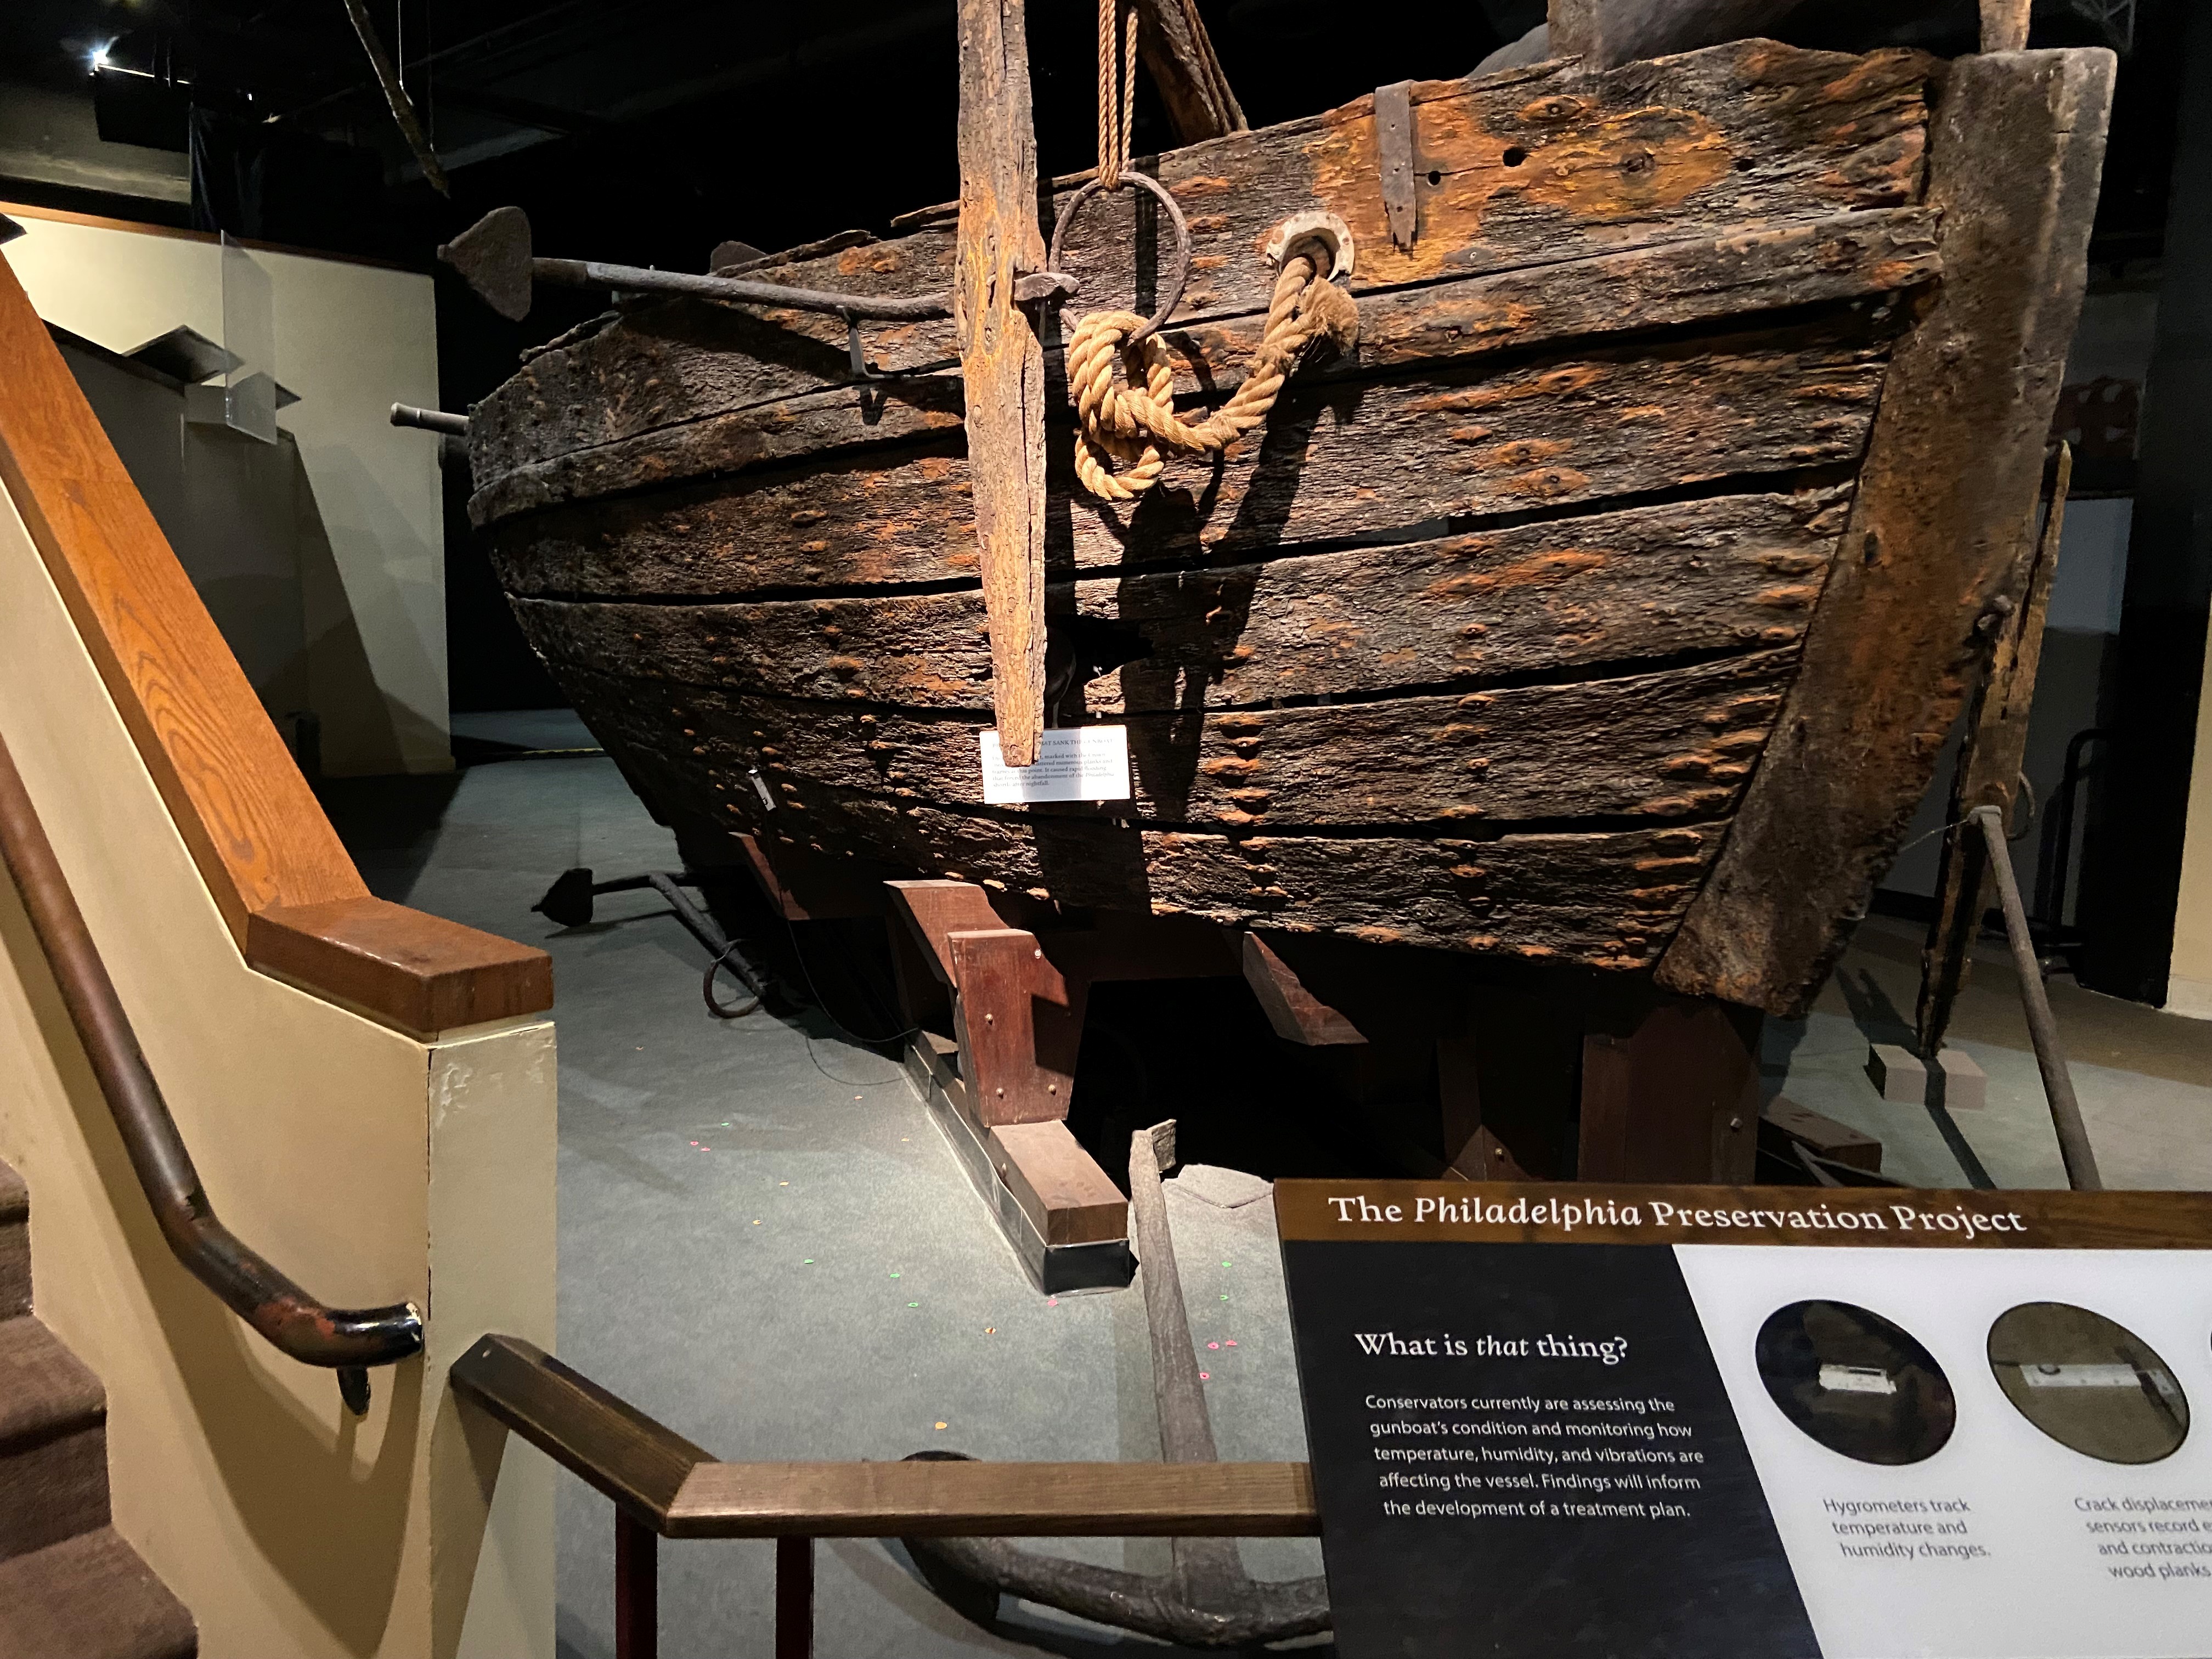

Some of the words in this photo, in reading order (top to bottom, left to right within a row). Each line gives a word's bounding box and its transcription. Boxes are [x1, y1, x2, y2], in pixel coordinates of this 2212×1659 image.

[1328, 1195, 1403, 1224] The
[1414, 1196, 1642, 1232] Philadelphia
[1648, 1201, 1889, 1229] Preservation
[1889, 1205, 2027, 1239] Project
[1354, 1331, 1438, 1356] What
[1444, 1333, 1468, 1356] is
[1476, 1335, 1529, 1357] that
[1536, 1334, 1628, 1365] thing?
[1365, 1395, 1468, 1409] Conservators
[1471, 1396, 1540, 1413] currently
[1544, 1399, 1568, 1410] are
[1572, 1397, 1646, 1415] assessing
[1647, 1397, 1675, 1412] the
[1370, 1420, 1448, 1437] gunboat's
[1452, 1420, 1528, 1435] condition
[1532, 1421, 1562, 1436] and
[1565, 1422, 1655, 1440] monitoring
[1656, 1423, 1691, 1437] how
[1374, 1447, 1479, 1464] temperature,
[1481, 1446, 1558, 1465] humidity,
[1561, 1447, 1592, 1462] and
[1595, 1447, 1675, 1463] vibrations
[1679, 1452, 1704, 1463] are
[1379, 1472, 1451, 1492] affecting
[1454, 1472, 1481, 1488] the
[1485, 1472, 1539, 1488] vessel.
[1541, 1473, 1611, 1492] Findings
[1614, 1474, 1643, 1489] will
[1645, 1474, 1701, 1489] inform
[1384, 1500, 1411, 1515] the
[1415, 1499, 1526, 1519] development
[1530, 1500, 1545, 1516] of
[1550, 1504, 1560, 1516] a
[1562, 1502, 1646, 1517] treatment
[1649, 1501, 1690, 1520] plan.
[1822, 1498, 1928, 1516] Hygrometers
[1929, 1498, 1971, 1513] track
[2074, 1497, 2120, 1511] Crack
[1832, 1522, 1934, 1538] temperature
[1937, 1519, 1968, 1534] and
[2086, 1521, 2147, 1533] sensors
[2148, 1518, 2200, 1533] record
[1839, 1542, 1914, 1561] humidity
[1918, 1542, 1991, 1560] changes.
[2098, 1540, 2129, 1555] and
[2108, 1562, 2156, 1578] wood
[2158, 1562, 2211, 1581] planks
